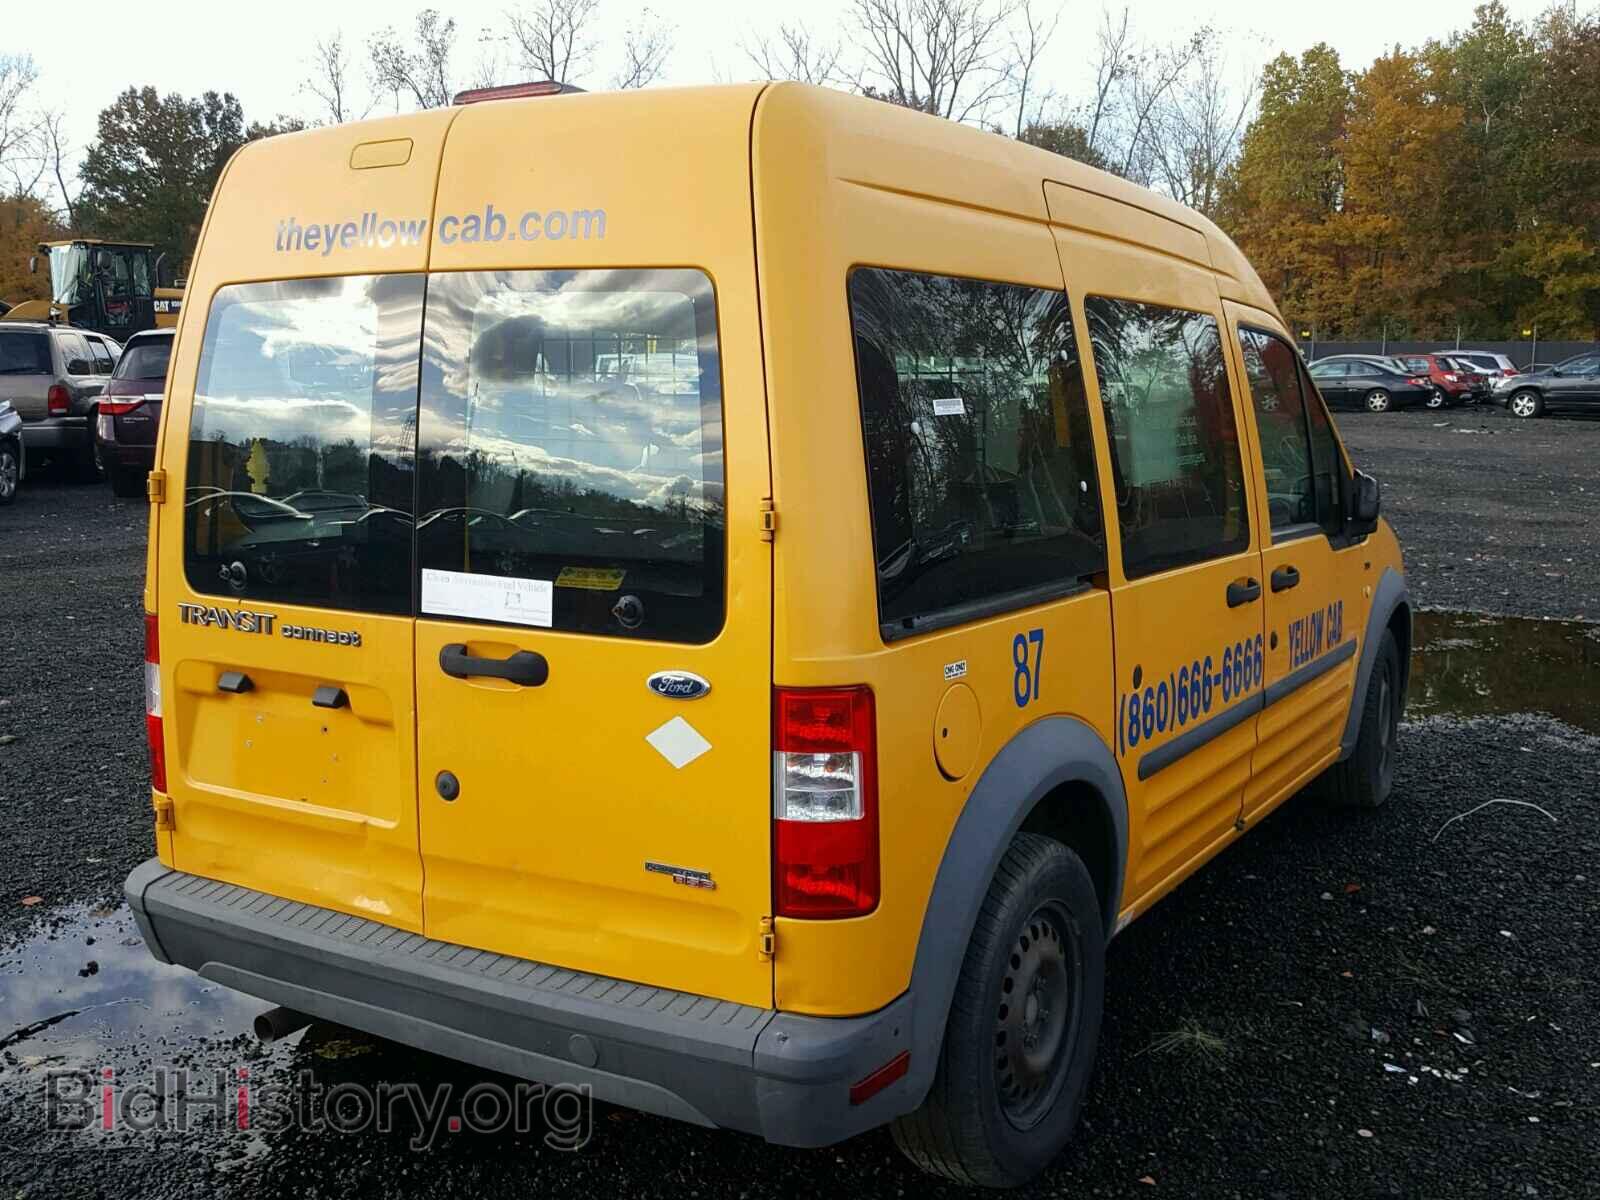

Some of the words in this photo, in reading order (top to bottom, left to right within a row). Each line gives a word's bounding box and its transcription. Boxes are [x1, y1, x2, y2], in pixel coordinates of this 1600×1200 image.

[275, 209, 427, 256] theyellow
[438, 204, 606, 244] cab.com
[153, 300, 169, 312] CAT
[177, 602, 277, 635] TRANSIT
[281, 623, 362, 648] connect
[1287, 607, 1325, 671] YELLOW
[1326, 600, 1344, 650] CAB
[657, 675, 694, 694] Ford
[1012, 627, 1044, 709] 87
[1118, 633, 1263, 759] (860)666-6666
